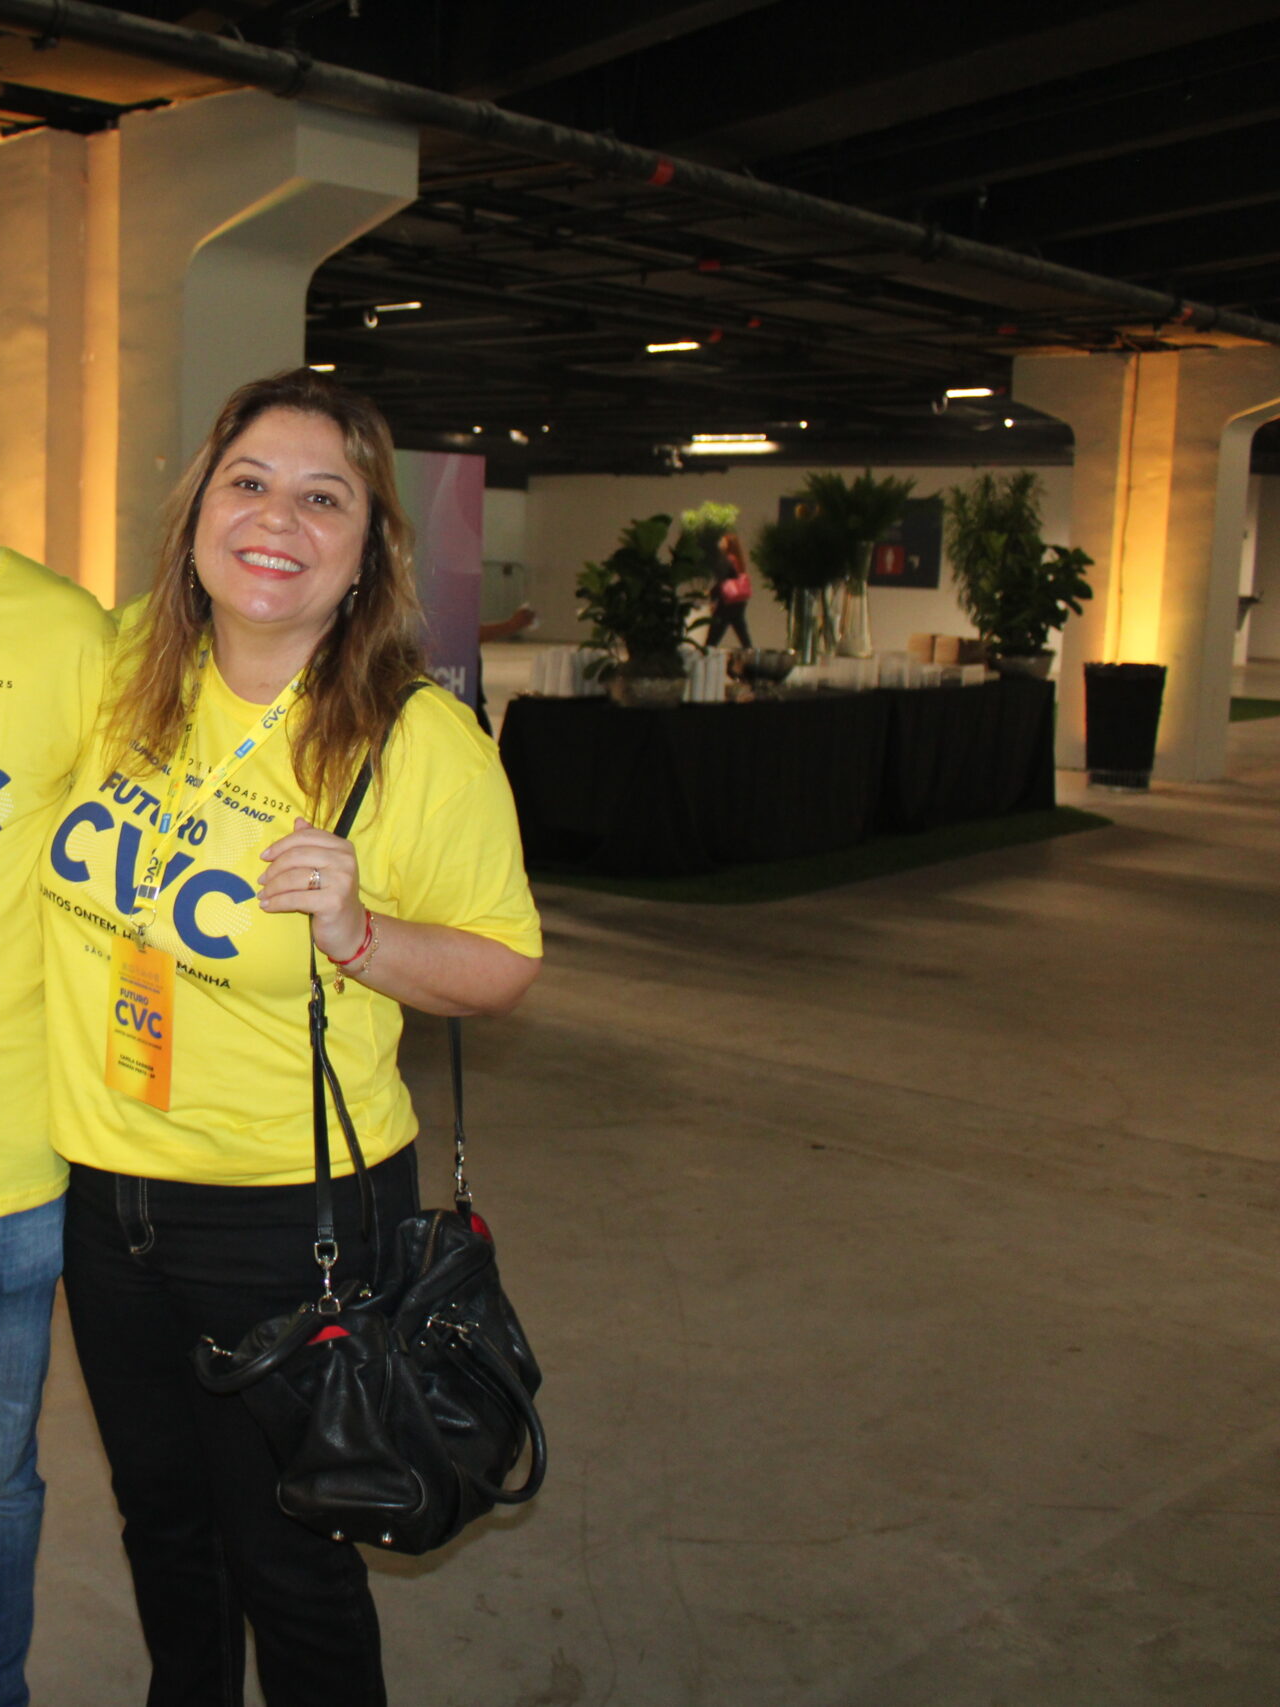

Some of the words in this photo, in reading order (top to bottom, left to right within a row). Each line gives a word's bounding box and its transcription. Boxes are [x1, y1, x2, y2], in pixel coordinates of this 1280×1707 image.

[262, 704, 287, 729] CVC
[222, 794, 240, 810] 50
[239, 804, 276, 823] ANOS
[262, 796, 292, 813] 2025
[50, 800, 257, 960] CVC
[143, 856, 159, 884] CVC
[176, 959, 232, 990] MANHÃ
[120, 988, 150, 1006] FUTURO
[114, 998, 163, 1040] CVC
